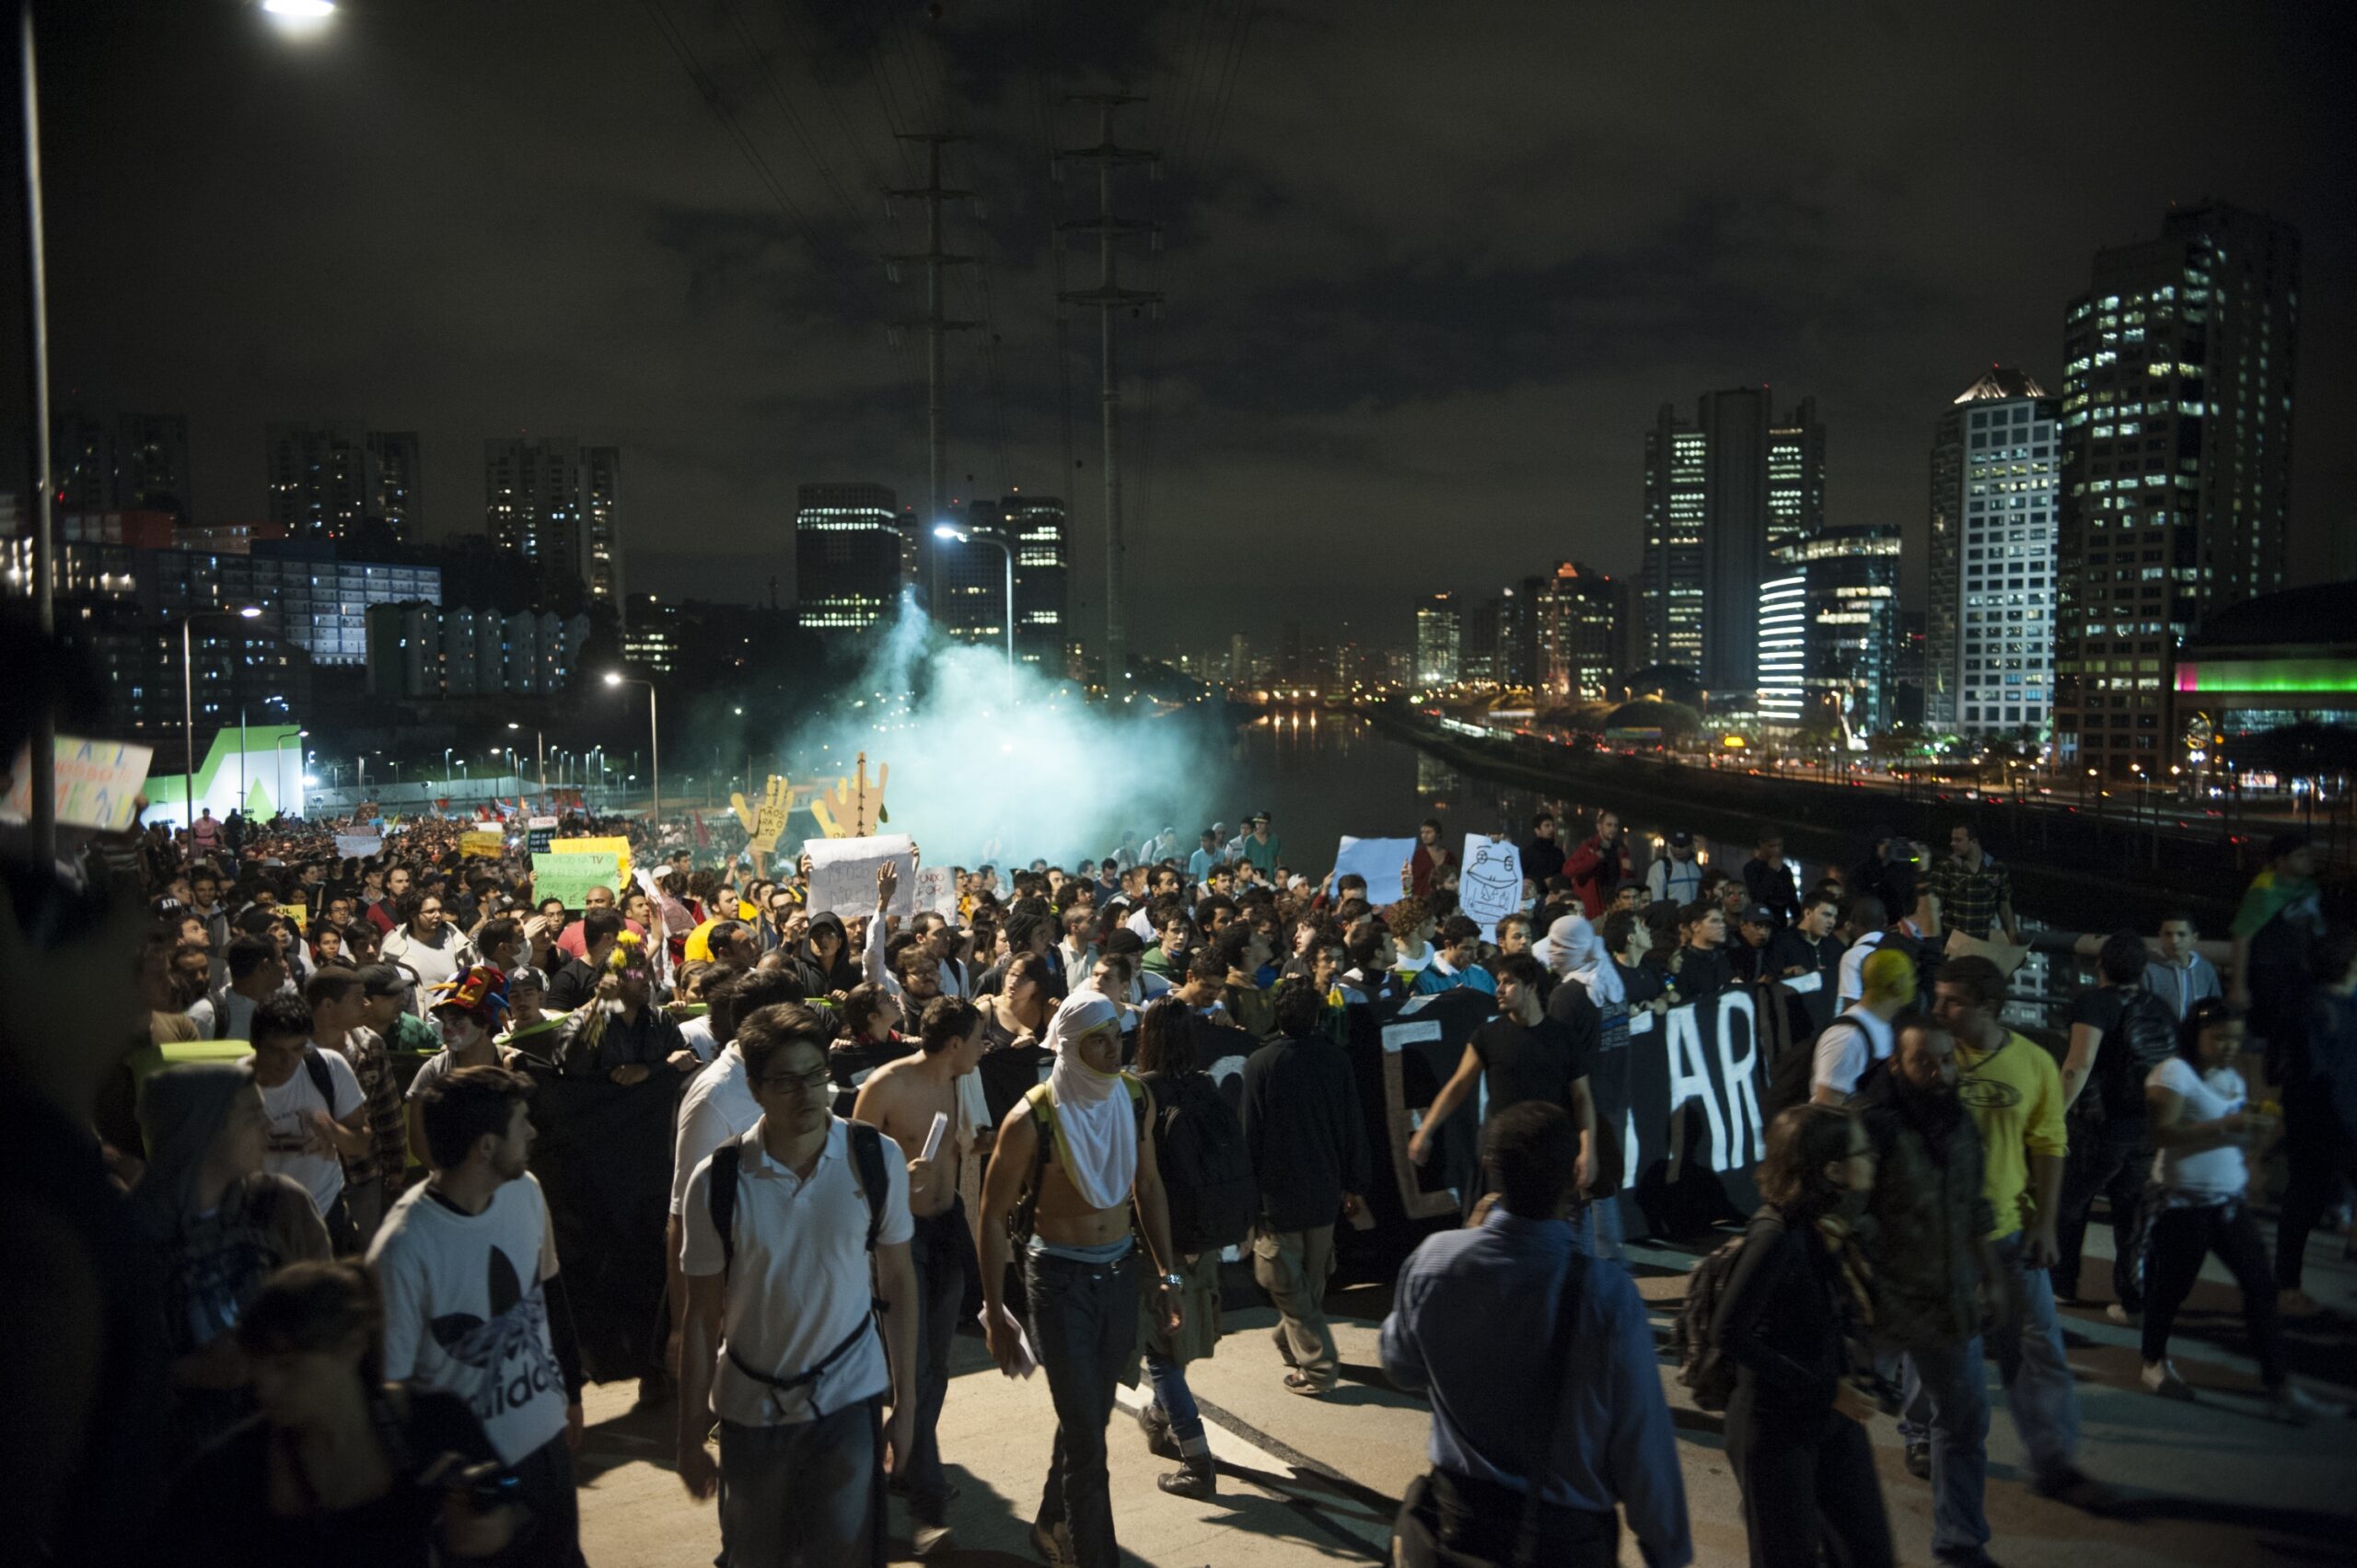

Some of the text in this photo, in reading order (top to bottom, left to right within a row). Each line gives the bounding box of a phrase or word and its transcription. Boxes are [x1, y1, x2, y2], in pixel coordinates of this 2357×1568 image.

[760, 806, 785, 819] MÃOS
[589, 855, 604, 865] TV
[918, 873, 945, 884] UNDO
